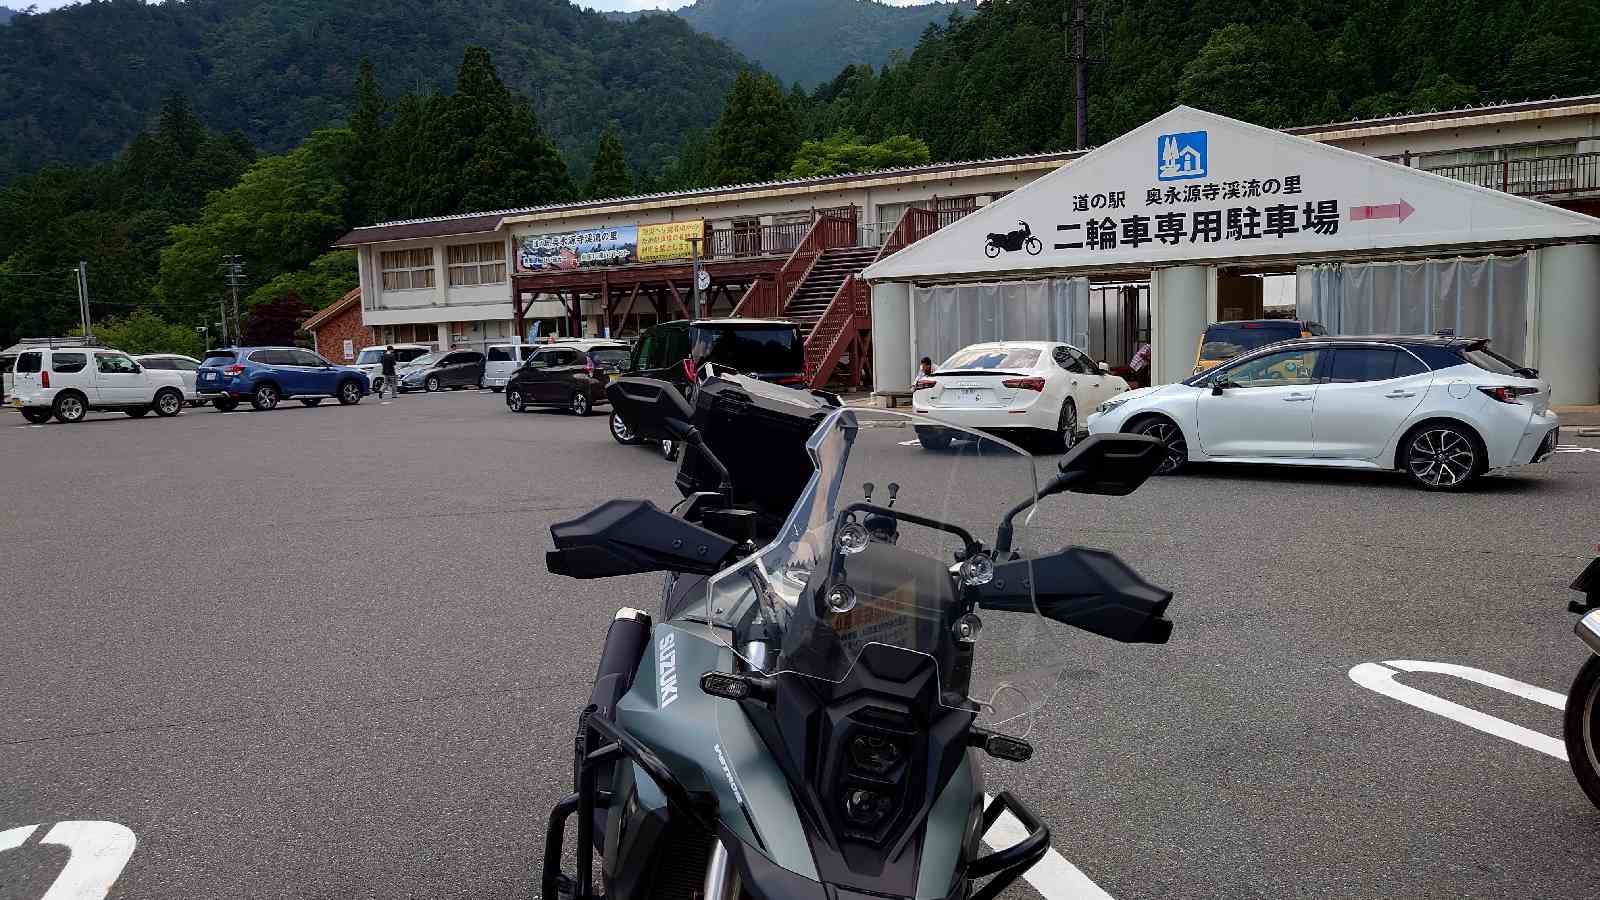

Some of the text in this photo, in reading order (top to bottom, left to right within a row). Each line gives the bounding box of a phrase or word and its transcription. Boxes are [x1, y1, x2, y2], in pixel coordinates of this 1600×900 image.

[1072, 175, 1302, 212] 道の駅 奥永源寺渓流の里
[1054, 200, 1340, 250] 二輪車専用駐車場
[659, 633, 679, 710] SUZUKI
